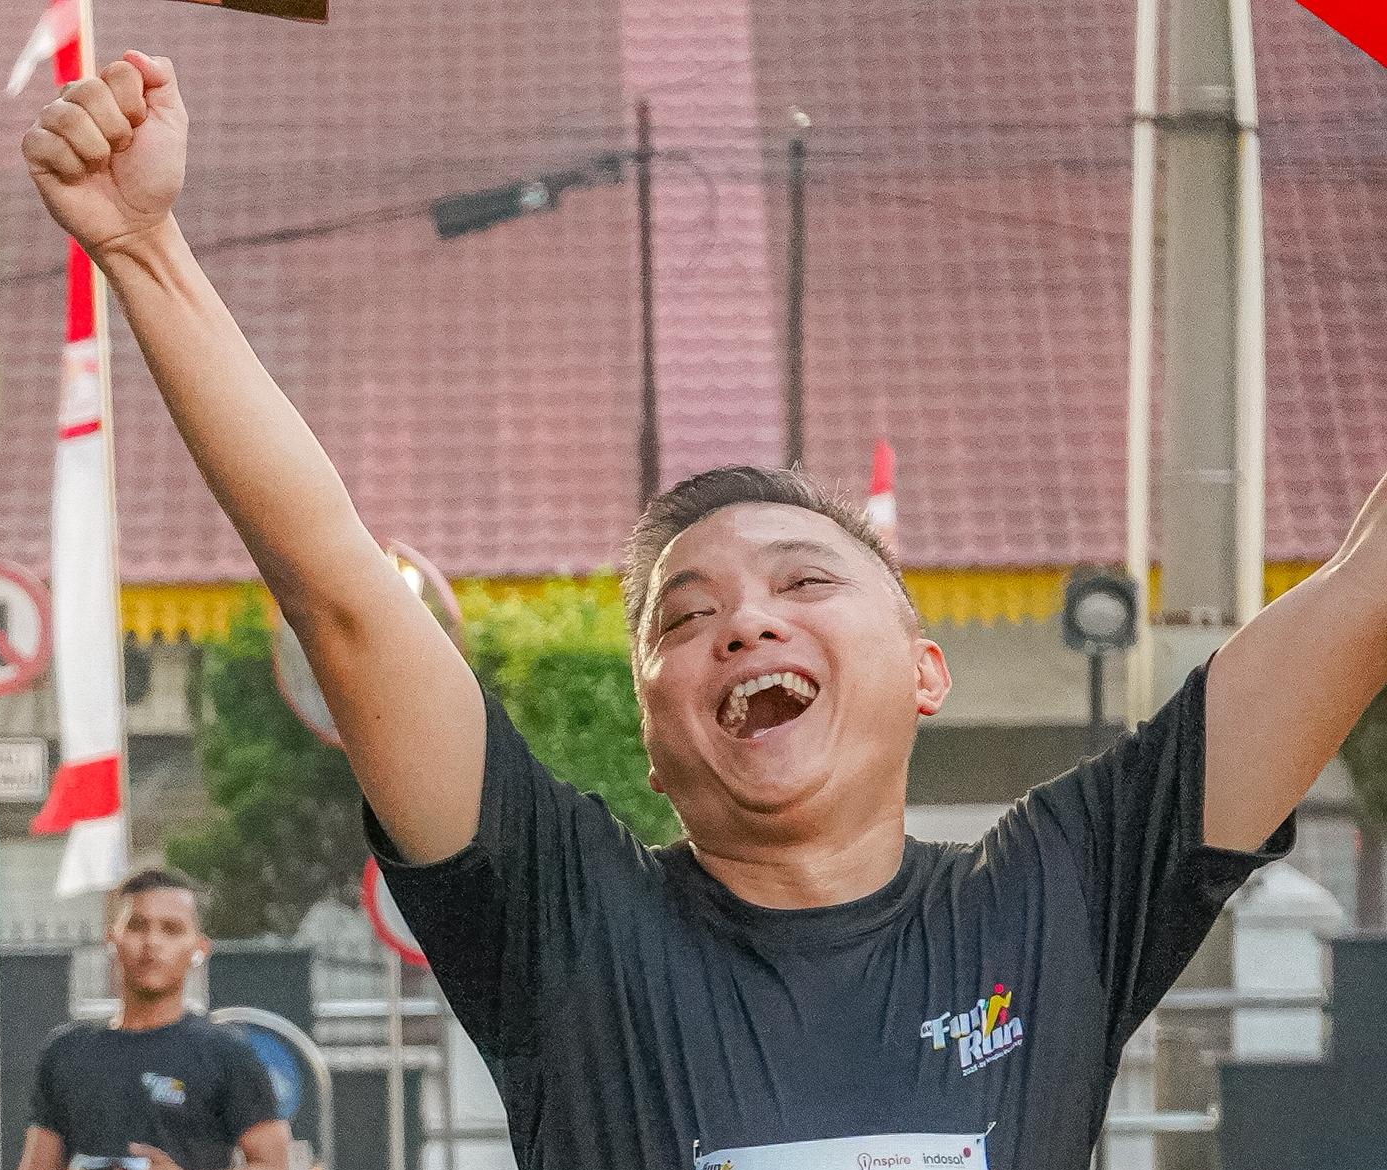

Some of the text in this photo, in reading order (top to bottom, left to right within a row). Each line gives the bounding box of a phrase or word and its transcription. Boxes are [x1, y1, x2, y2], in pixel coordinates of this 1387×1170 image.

[931, 998, 989, 1051] Fun
[958, 1016, 1024, 1069] Run
[922, 1152, 965, 1166] indosat
